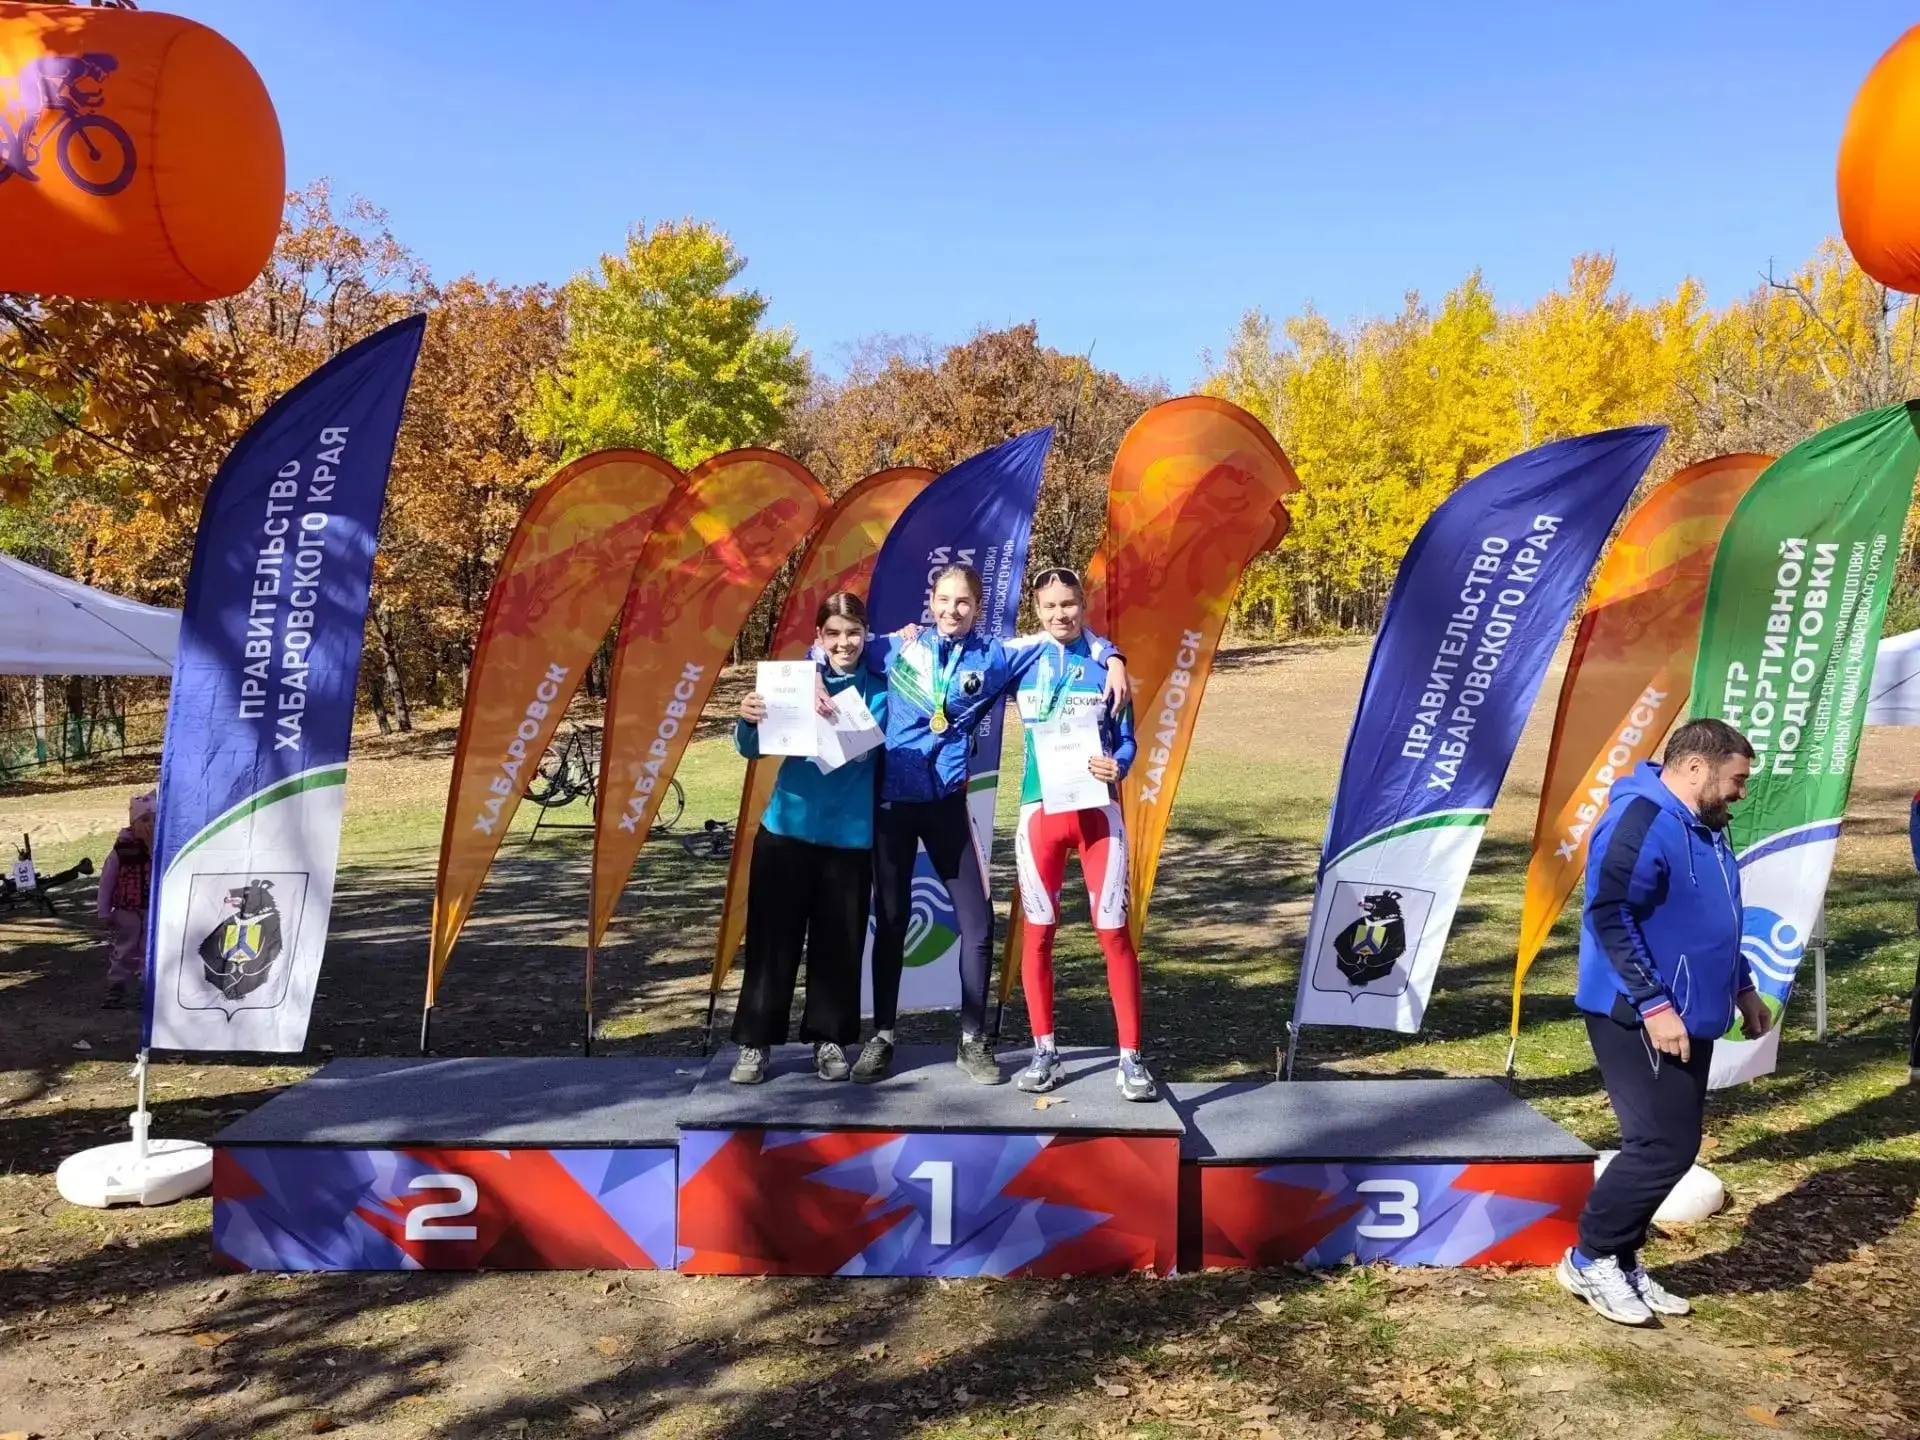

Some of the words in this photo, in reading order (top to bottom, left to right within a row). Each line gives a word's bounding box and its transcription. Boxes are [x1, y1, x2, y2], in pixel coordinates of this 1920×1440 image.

[239, 459, 302, 719] ПРАВИТЕЛЬСТВО
[274, 511, 328, 753] ХАБАРОВСКОГО
[307, 425, 349, 504] КРАЯ
[1840, 541, 1866, 622] ПОДГОТОВКИ
[1869, 534, 1887, 572] КРАЯ»
[1402, 536, 1509, 760] ПРАВИТЕЛЬСТВО
[1427, 587, 1525, 792] ХАБАРОВСКОГО
[1507, 513, 1563, 586] КРАЯ
[1748, 538, 1808, 775] СПОРТИВНОЙ
[1772, 543, 1839, 775] ПОДГОТОВКИ
[1823, 620, 1845, 691] СПОРТИВНОЙ
[1851, 573, 1877, 665] ХАБАРОВСКОГО
[1139, 629, 1204, 805] ХАБАРОВСК
[1722, 661, 1749, 728] НТР
[1813, 695, 1833, 742] «ЦЕНТР
[1840, 665, 1860, 717] КОМАНД
[472, 661, 570, 835] ХАБАРОВСК
[618, 662, 704, 834] ХАБАРОВСК
[1553, 683, 1668, 864] ХАБАРОВСК
[1807, 744, 1826, 776] КГАУ
[1830, 718, 1851, 775] СБОРНЫХ
[405, 1174, 478, 1241] 2
[909, 1161, 953, 1245] 1
[1357, 1180, 1419, 1238] 3
